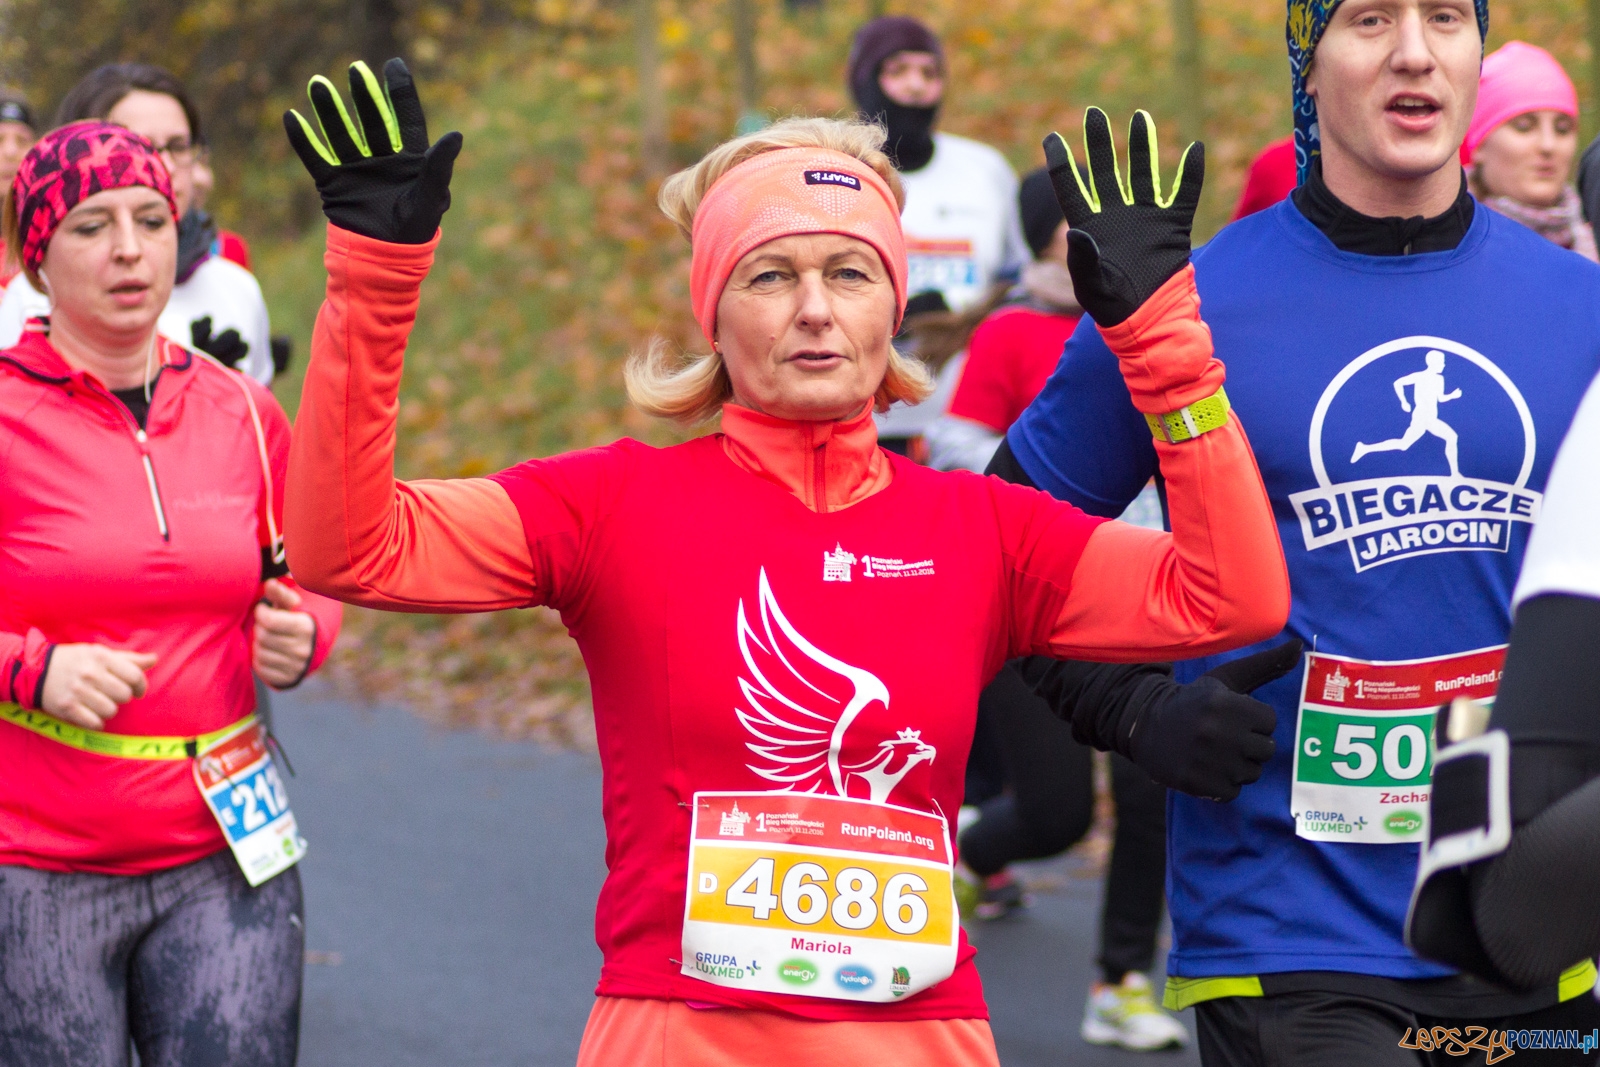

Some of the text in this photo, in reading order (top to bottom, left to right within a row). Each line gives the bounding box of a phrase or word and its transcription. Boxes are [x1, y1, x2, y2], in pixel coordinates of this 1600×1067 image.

[821, 173, 856, 185] CRAFT
[1302, 484, 1535, 539] BIEGACZE
[1360, 521, 1502, 560] JAROCIN
[861, 555, 903, 577] 1 Poznański
[903, 568, 935, 577] 11.11.2016
[1354, 679, 1365, 699] 1
[1303, 722, 1436, 780] C 50
[755, 812, 798, 832] 1 Poznański
[766, 819, 825, 828] Bieg Niepodległości
[1305, 811, 1345, 823] GRUPA
[1389, 820, 1421, 830] energy
[795, 827, 824, 836] 11.11.2016
[841, 822, 935, 851] RunPoland.org
[1304, 822, 1353, 834] LUXMED
[698, 857, 929, 936] D 4686
[791, 937, 852, 955] Mariola
[695, 951, 738, 967] GRUPA
[695, 961, 744, 980] LUXMED
[783, 969, 816, 981] energy
